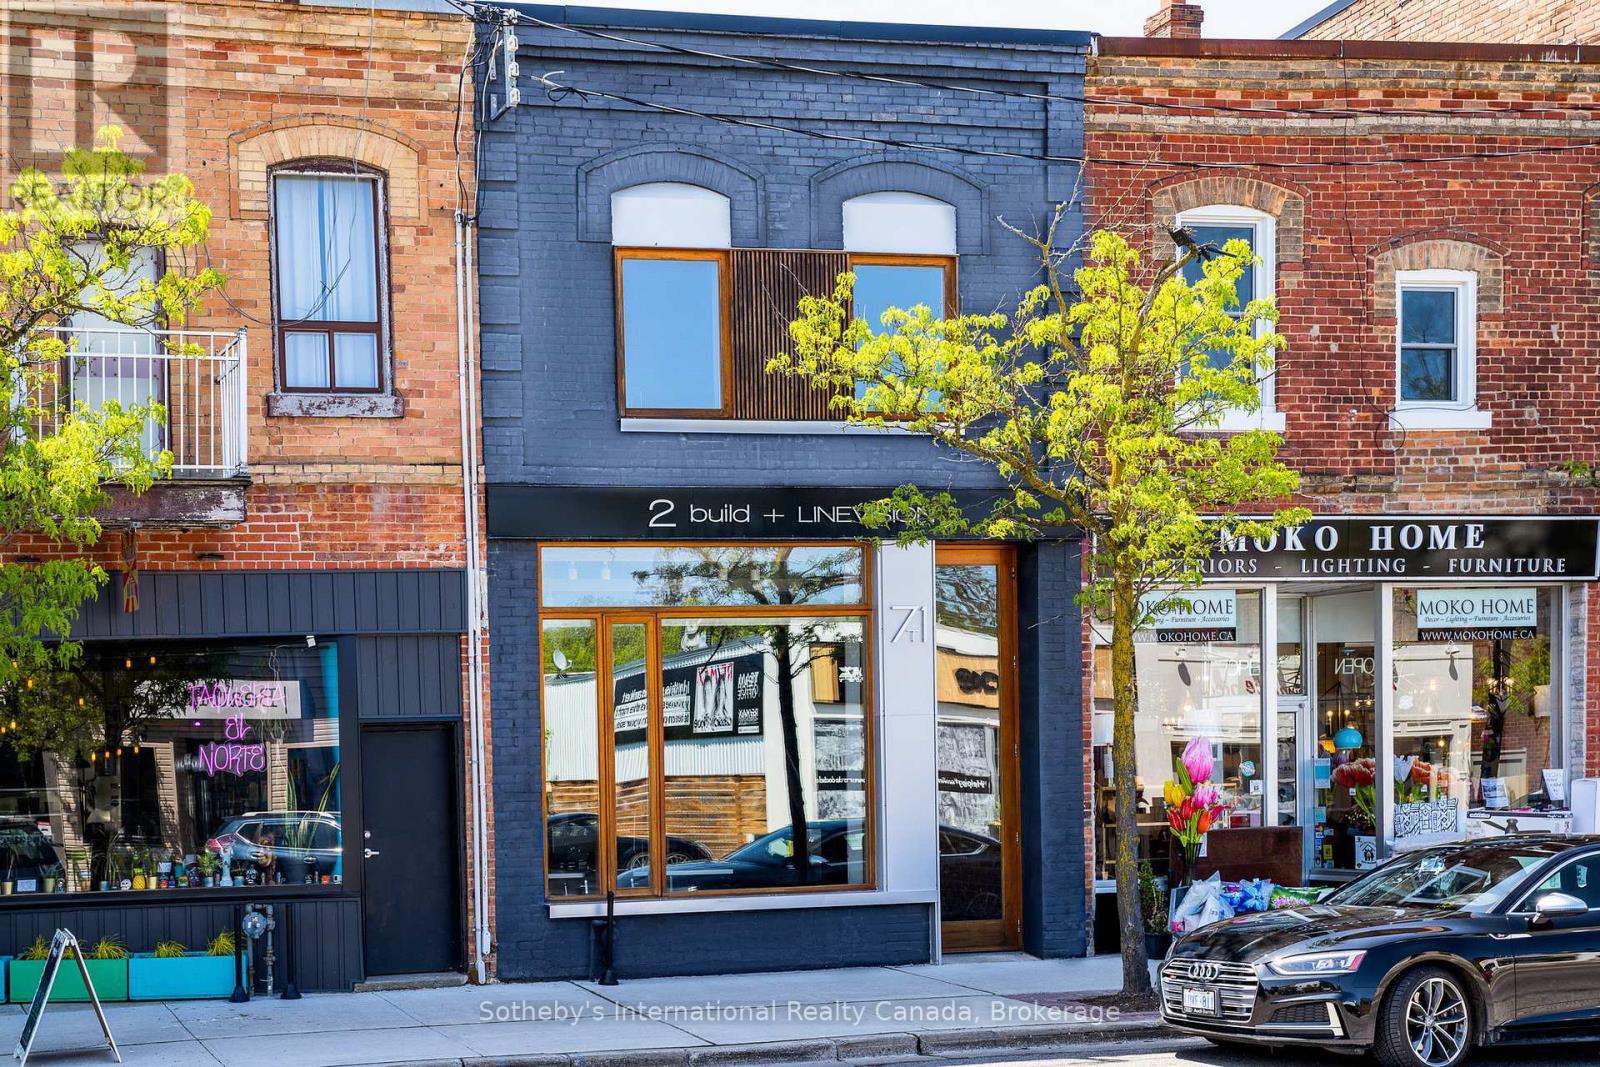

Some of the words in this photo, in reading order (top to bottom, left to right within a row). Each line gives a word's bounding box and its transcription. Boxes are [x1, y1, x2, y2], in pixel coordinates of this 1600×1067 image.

[648, 499, 677, 528] 2
[690, 504, 750, 523] build
[1219, 525, 1339, 552] MOKO
[1369, 523, 1485, 551] HOME
[1301, 558, 1406, 574] LIGHTING
[1448, 557, 1566, 573] FURNITURE
[1419, 599, 1475, 616] MOKO
[1481, 598, 1534, 614] HOME
[1445, 616, 1468, 624] Lighting
[1421, 630, 1534, 641] WWW.MOKOHOME.CA
[199, 742, 265, 776] NORTE
